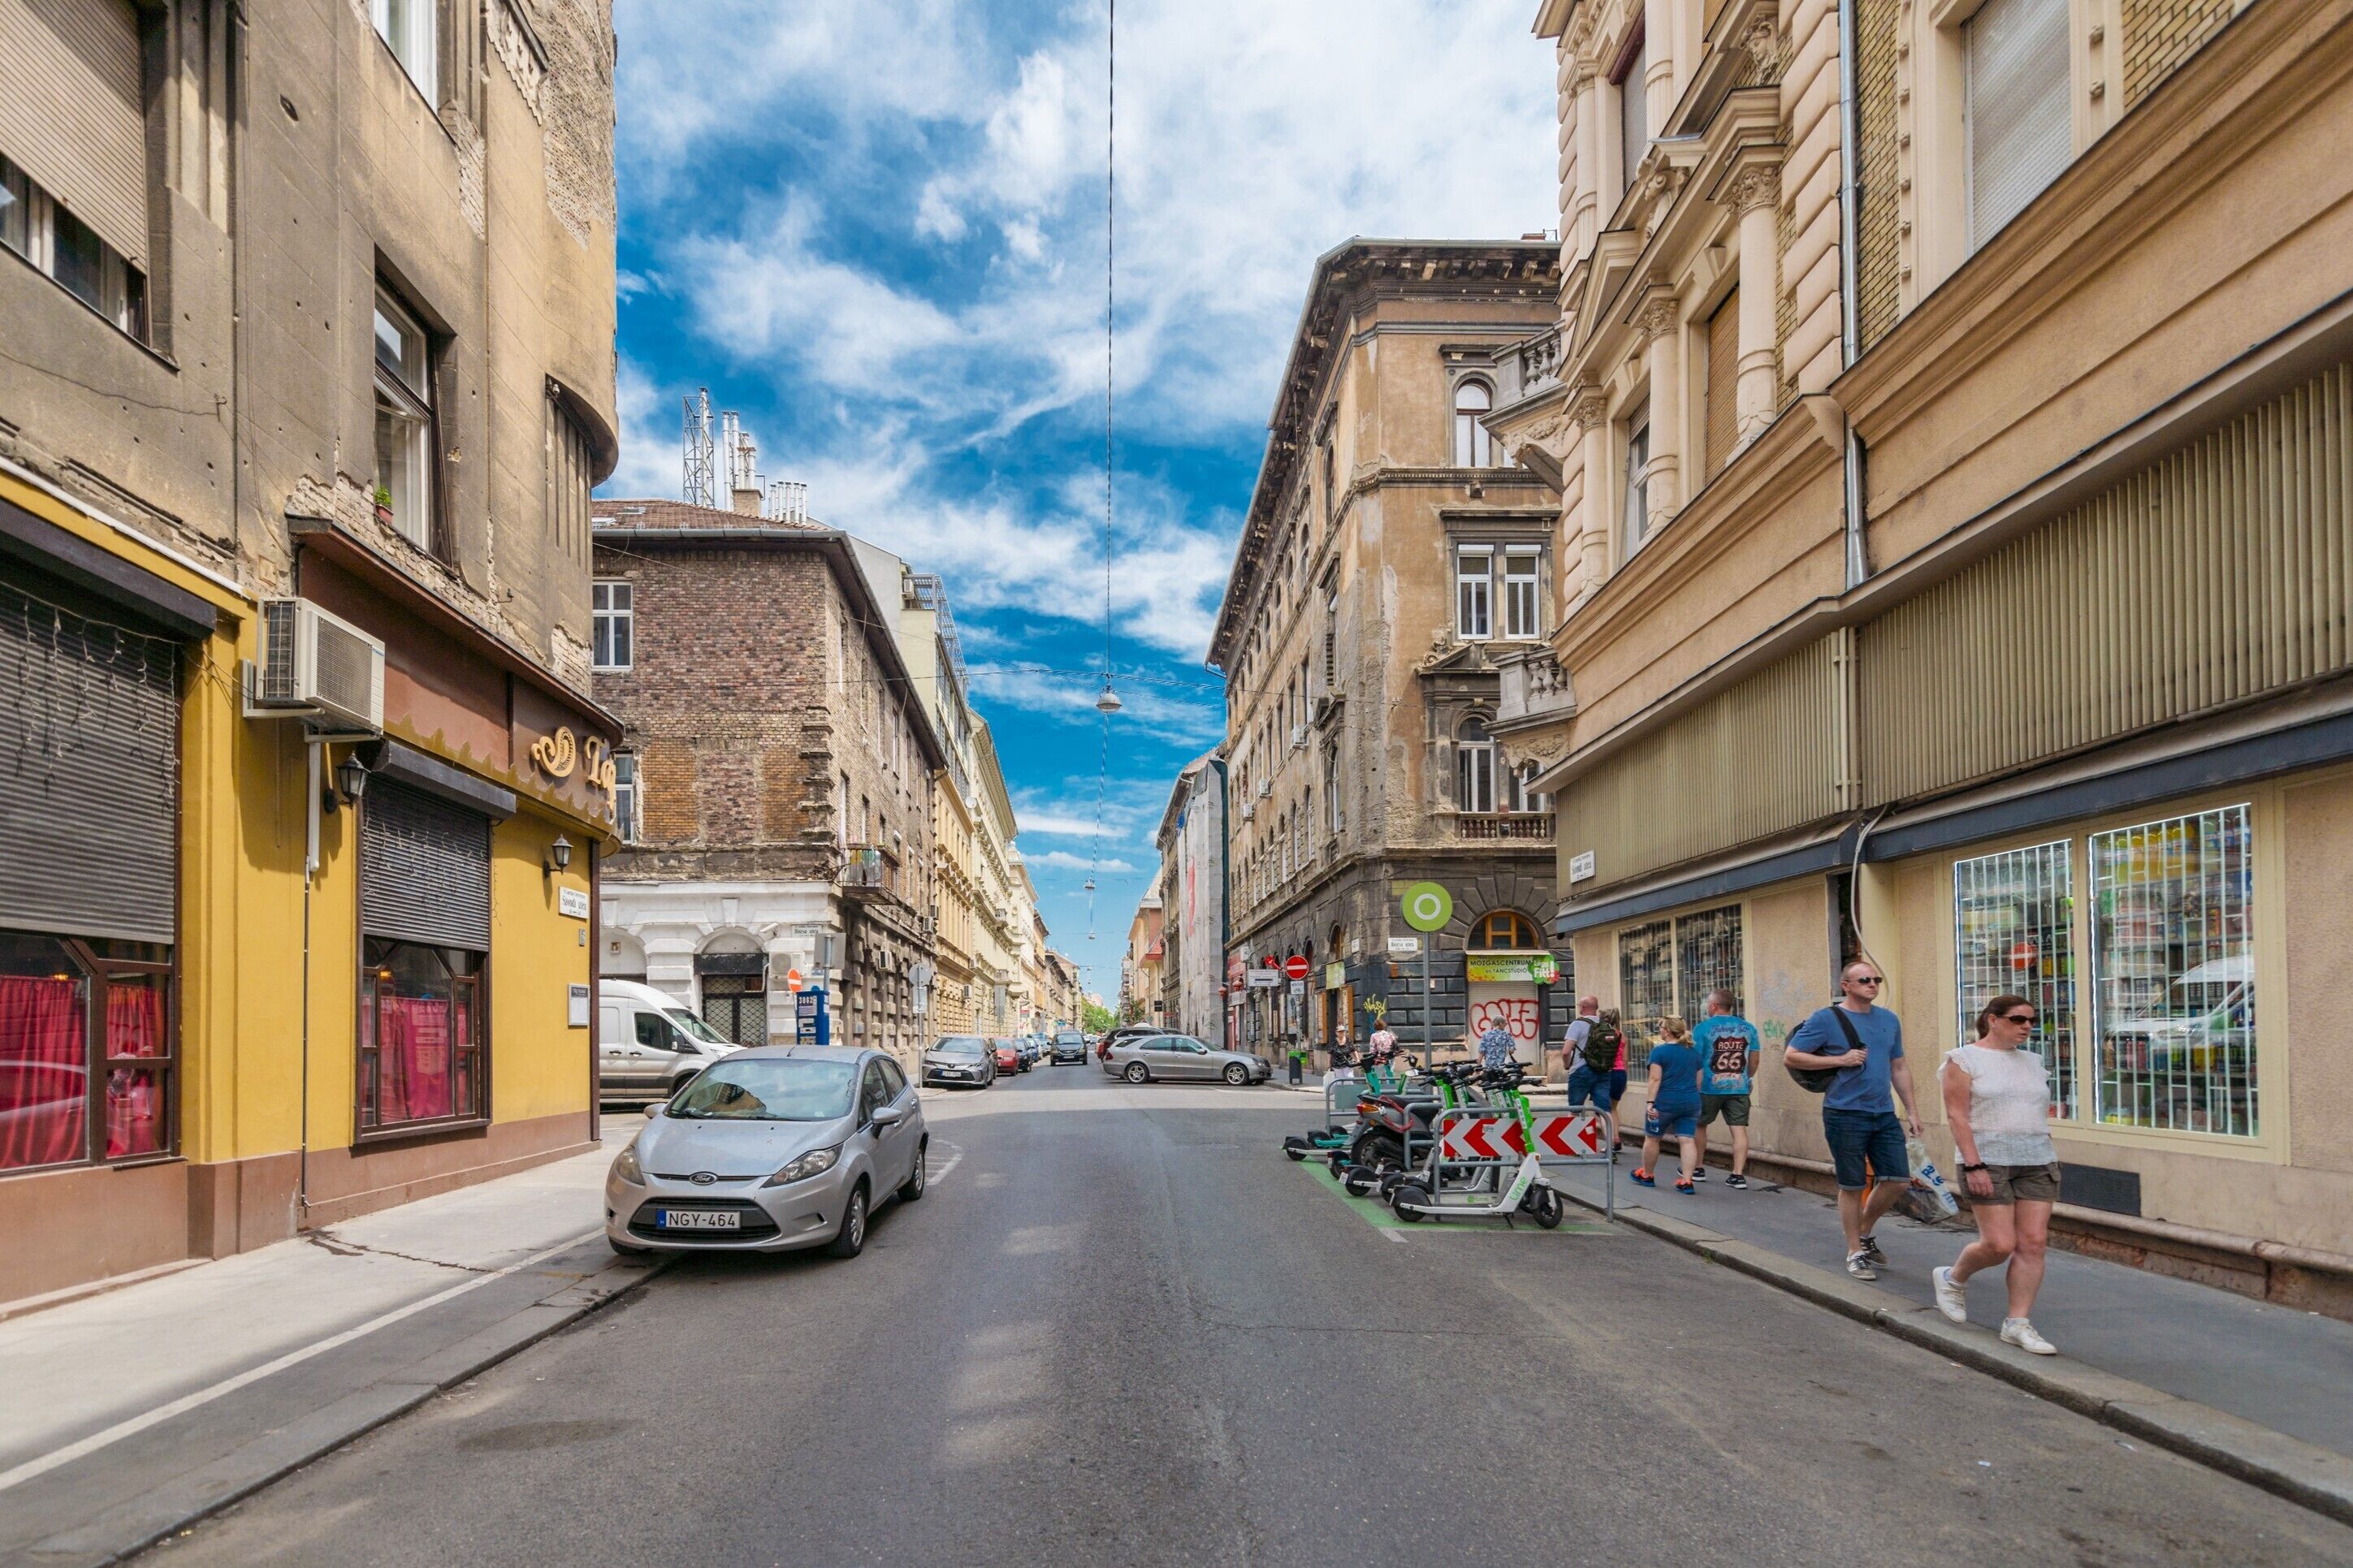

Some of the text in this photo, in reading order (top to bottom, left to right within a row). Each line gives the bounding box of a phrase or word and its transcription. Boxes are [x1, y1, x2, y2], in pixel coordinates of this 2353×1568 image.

[1718, 1041, 1744, 1050] ROUTE
[1716, 1052, 1742, 1070] 66
[694, 1174, 711, 1182] Ford
[668, 1212, 736, 1227] NGY-464
